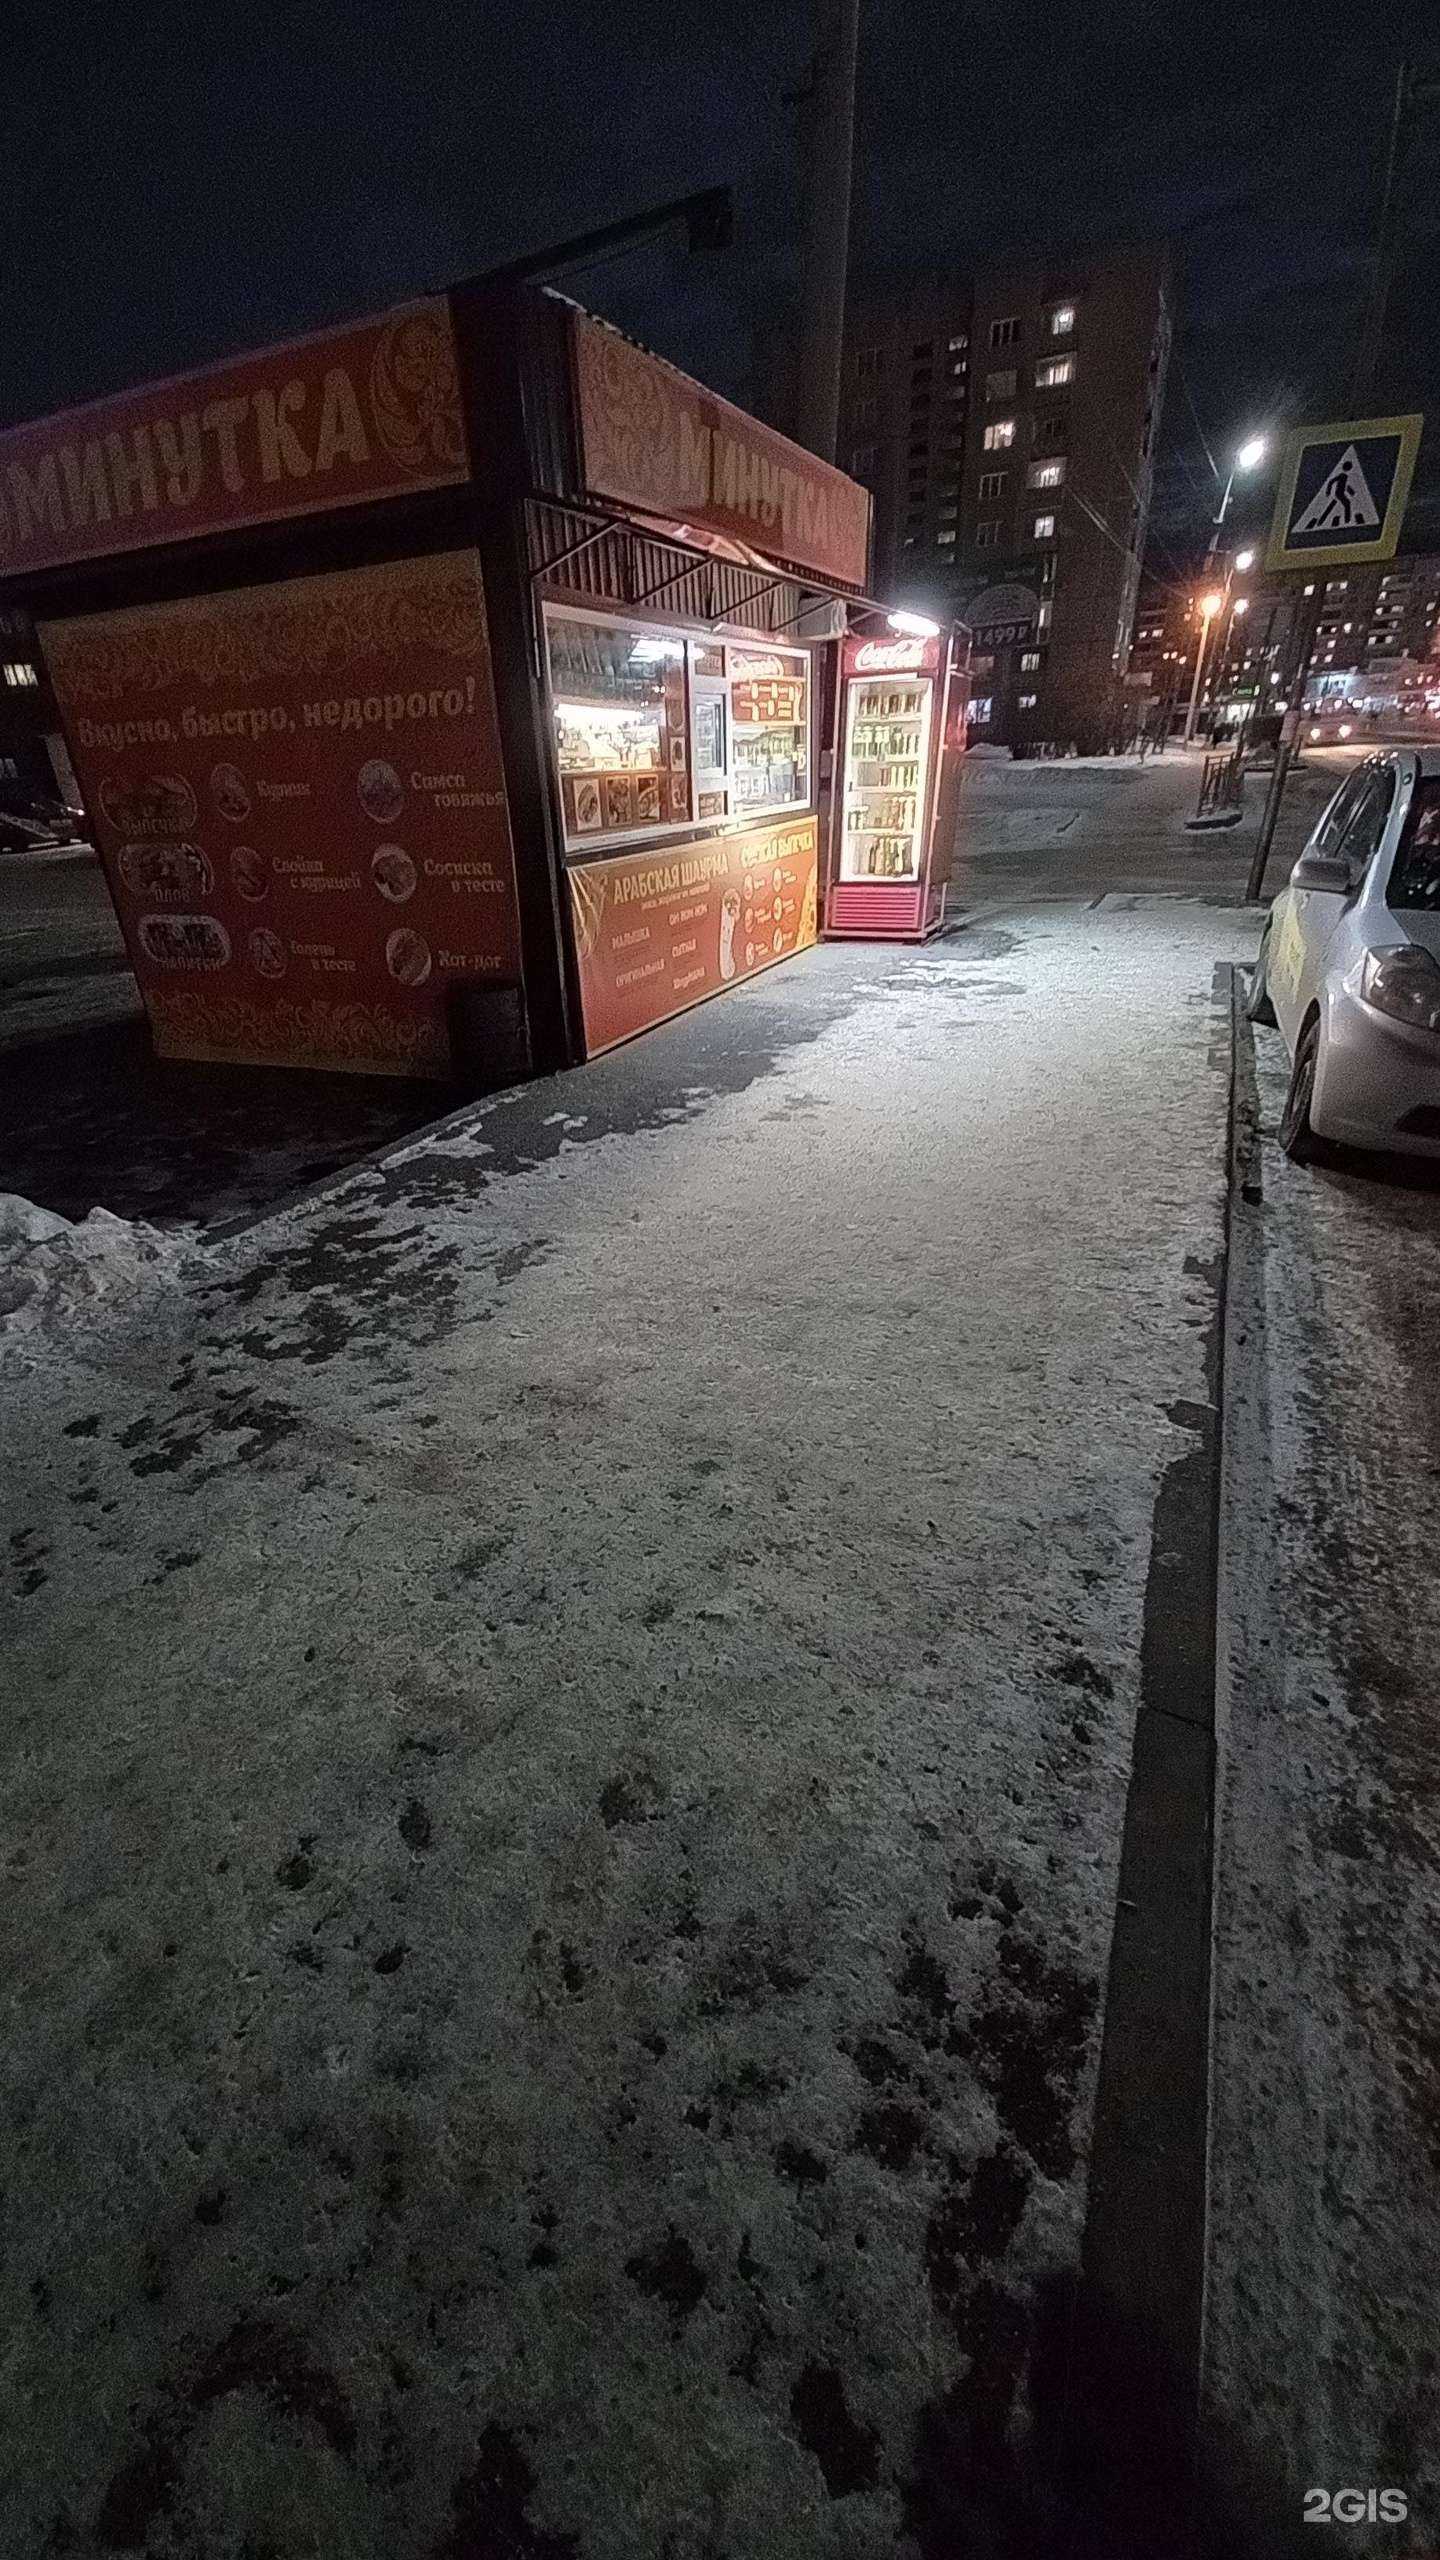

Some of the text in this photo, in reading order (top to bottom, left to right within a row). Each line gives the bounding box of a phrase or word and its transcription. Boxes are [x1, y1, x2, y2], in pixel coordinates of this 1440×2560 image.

[79, 674, 476, 752] Вкусно, быстро, недорого!
[614, 863, 681, 905] АРАБСКАЯ
[681, 853, 729, 887] ШАУРМА
